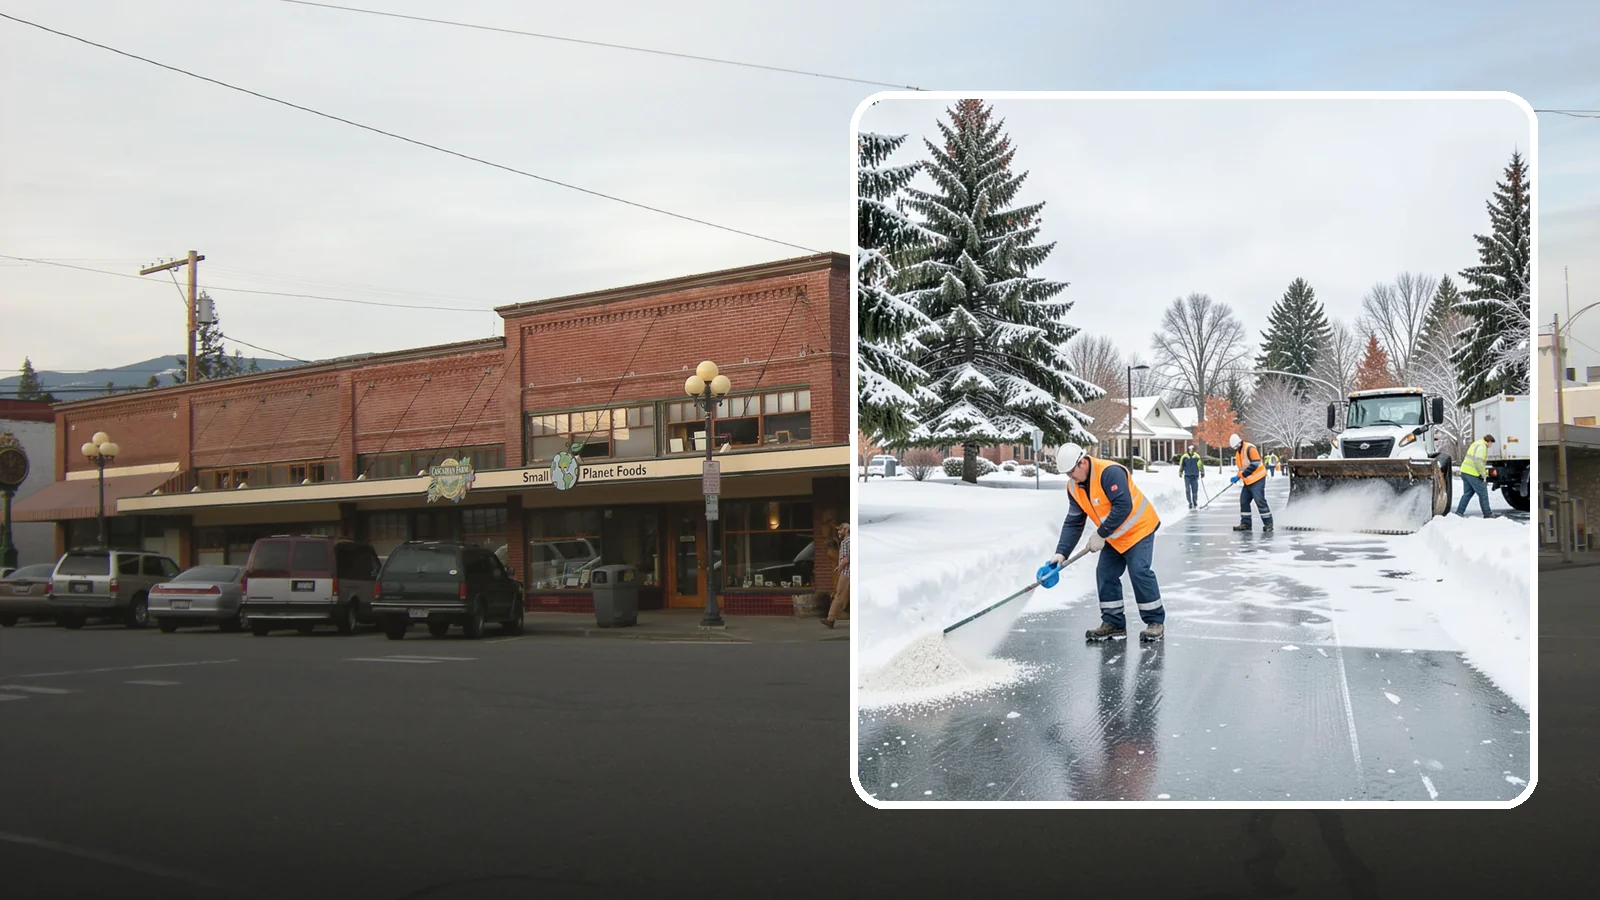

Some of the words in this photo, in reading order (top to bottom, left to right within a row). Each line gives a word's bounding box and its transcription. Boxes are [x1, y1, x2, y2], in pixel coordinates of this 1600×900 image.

[523, 471, 549, 483] Small
[583, 467, 614, 479] Planet
[617, 464, 647, 477] Foods
